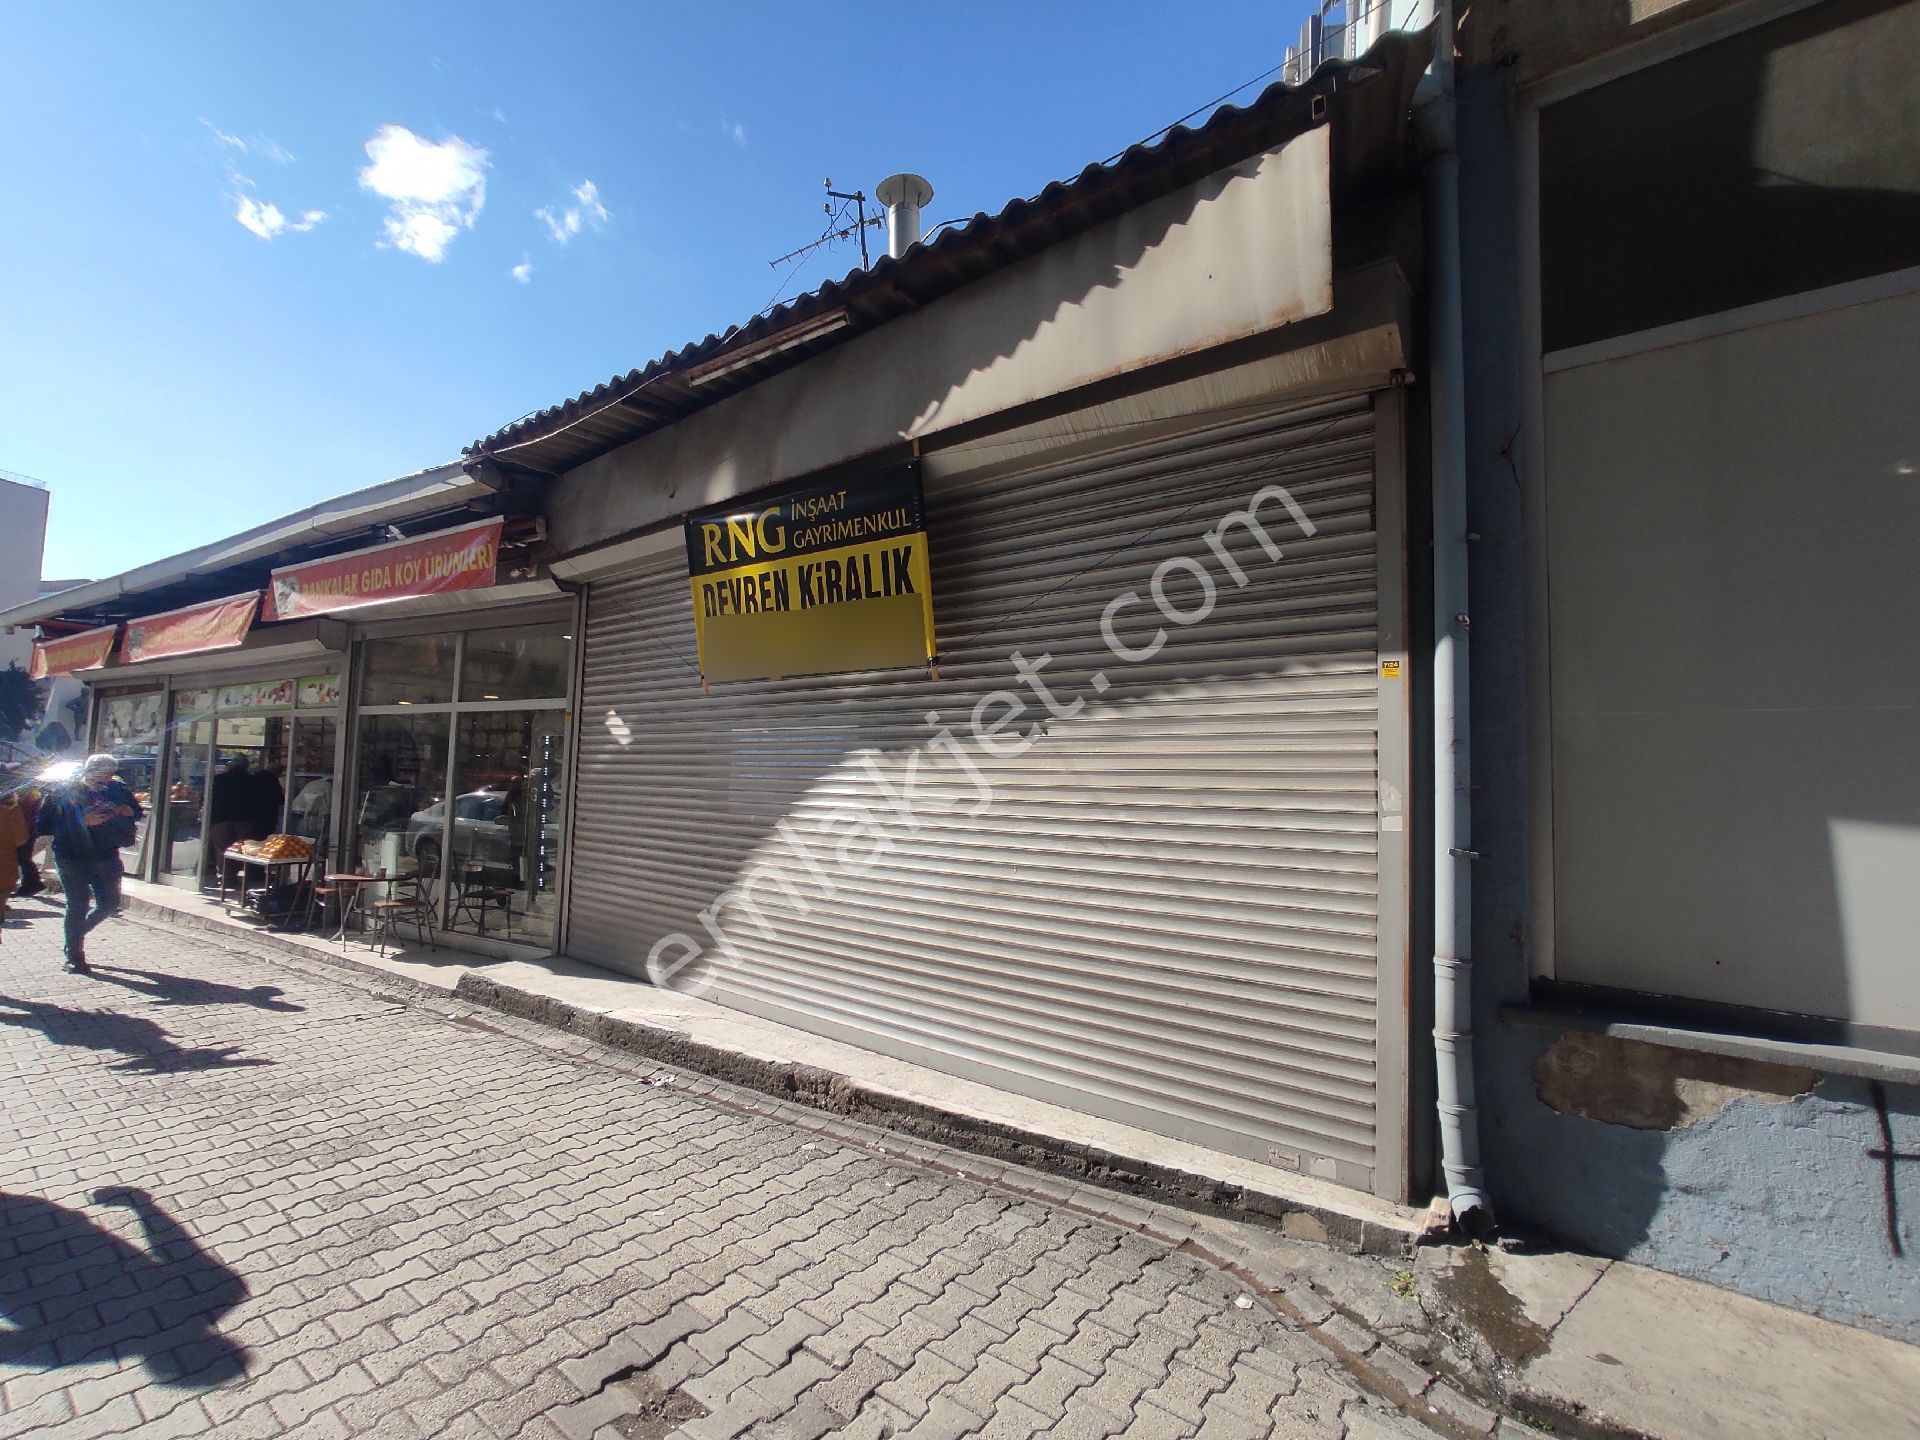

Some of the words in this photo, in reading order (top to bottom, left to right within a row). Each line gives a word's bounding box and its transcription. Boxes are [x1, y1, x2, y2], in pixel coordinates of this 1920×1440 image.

[790, 489, 848, 522] İNŞAAT
[702, 507, 787, 566] RNG
[793, 508, 912, 550] GAYRİMENKUL
[361, 566, 391, 592] GIDA
[395, 554, 420, 586] KÖY
